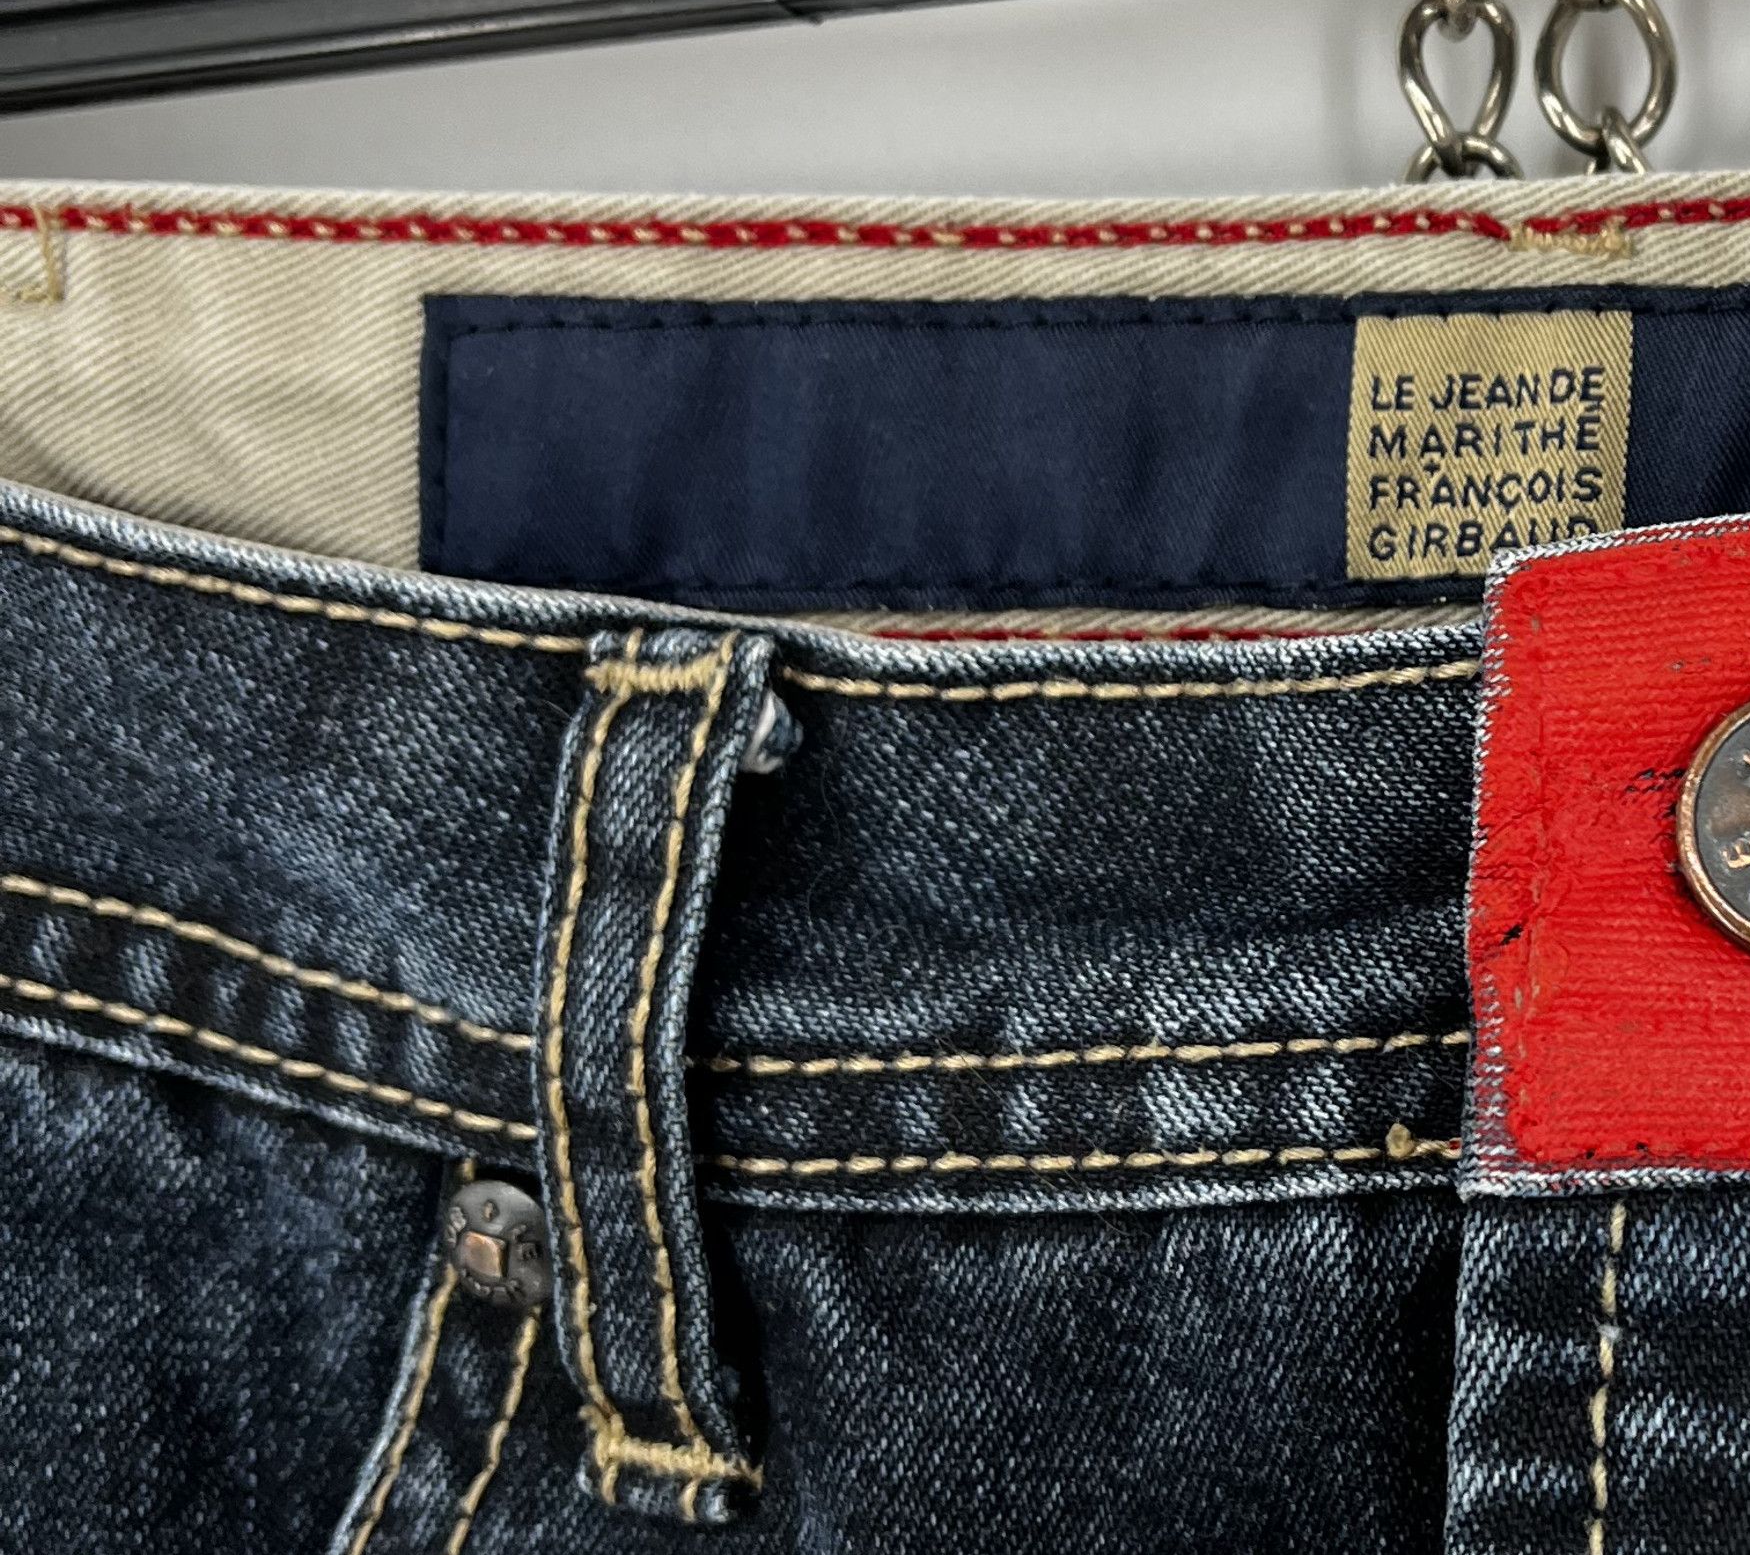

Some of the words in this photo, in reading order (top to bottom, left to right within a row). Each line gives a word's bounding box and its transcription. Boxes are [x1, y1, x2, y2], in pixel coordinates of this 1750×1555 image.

[1371, 374, 1415, 412] LE
[1429, 372, 1541, 411] JEAN
[1549, 366, 1606, 404] DE
